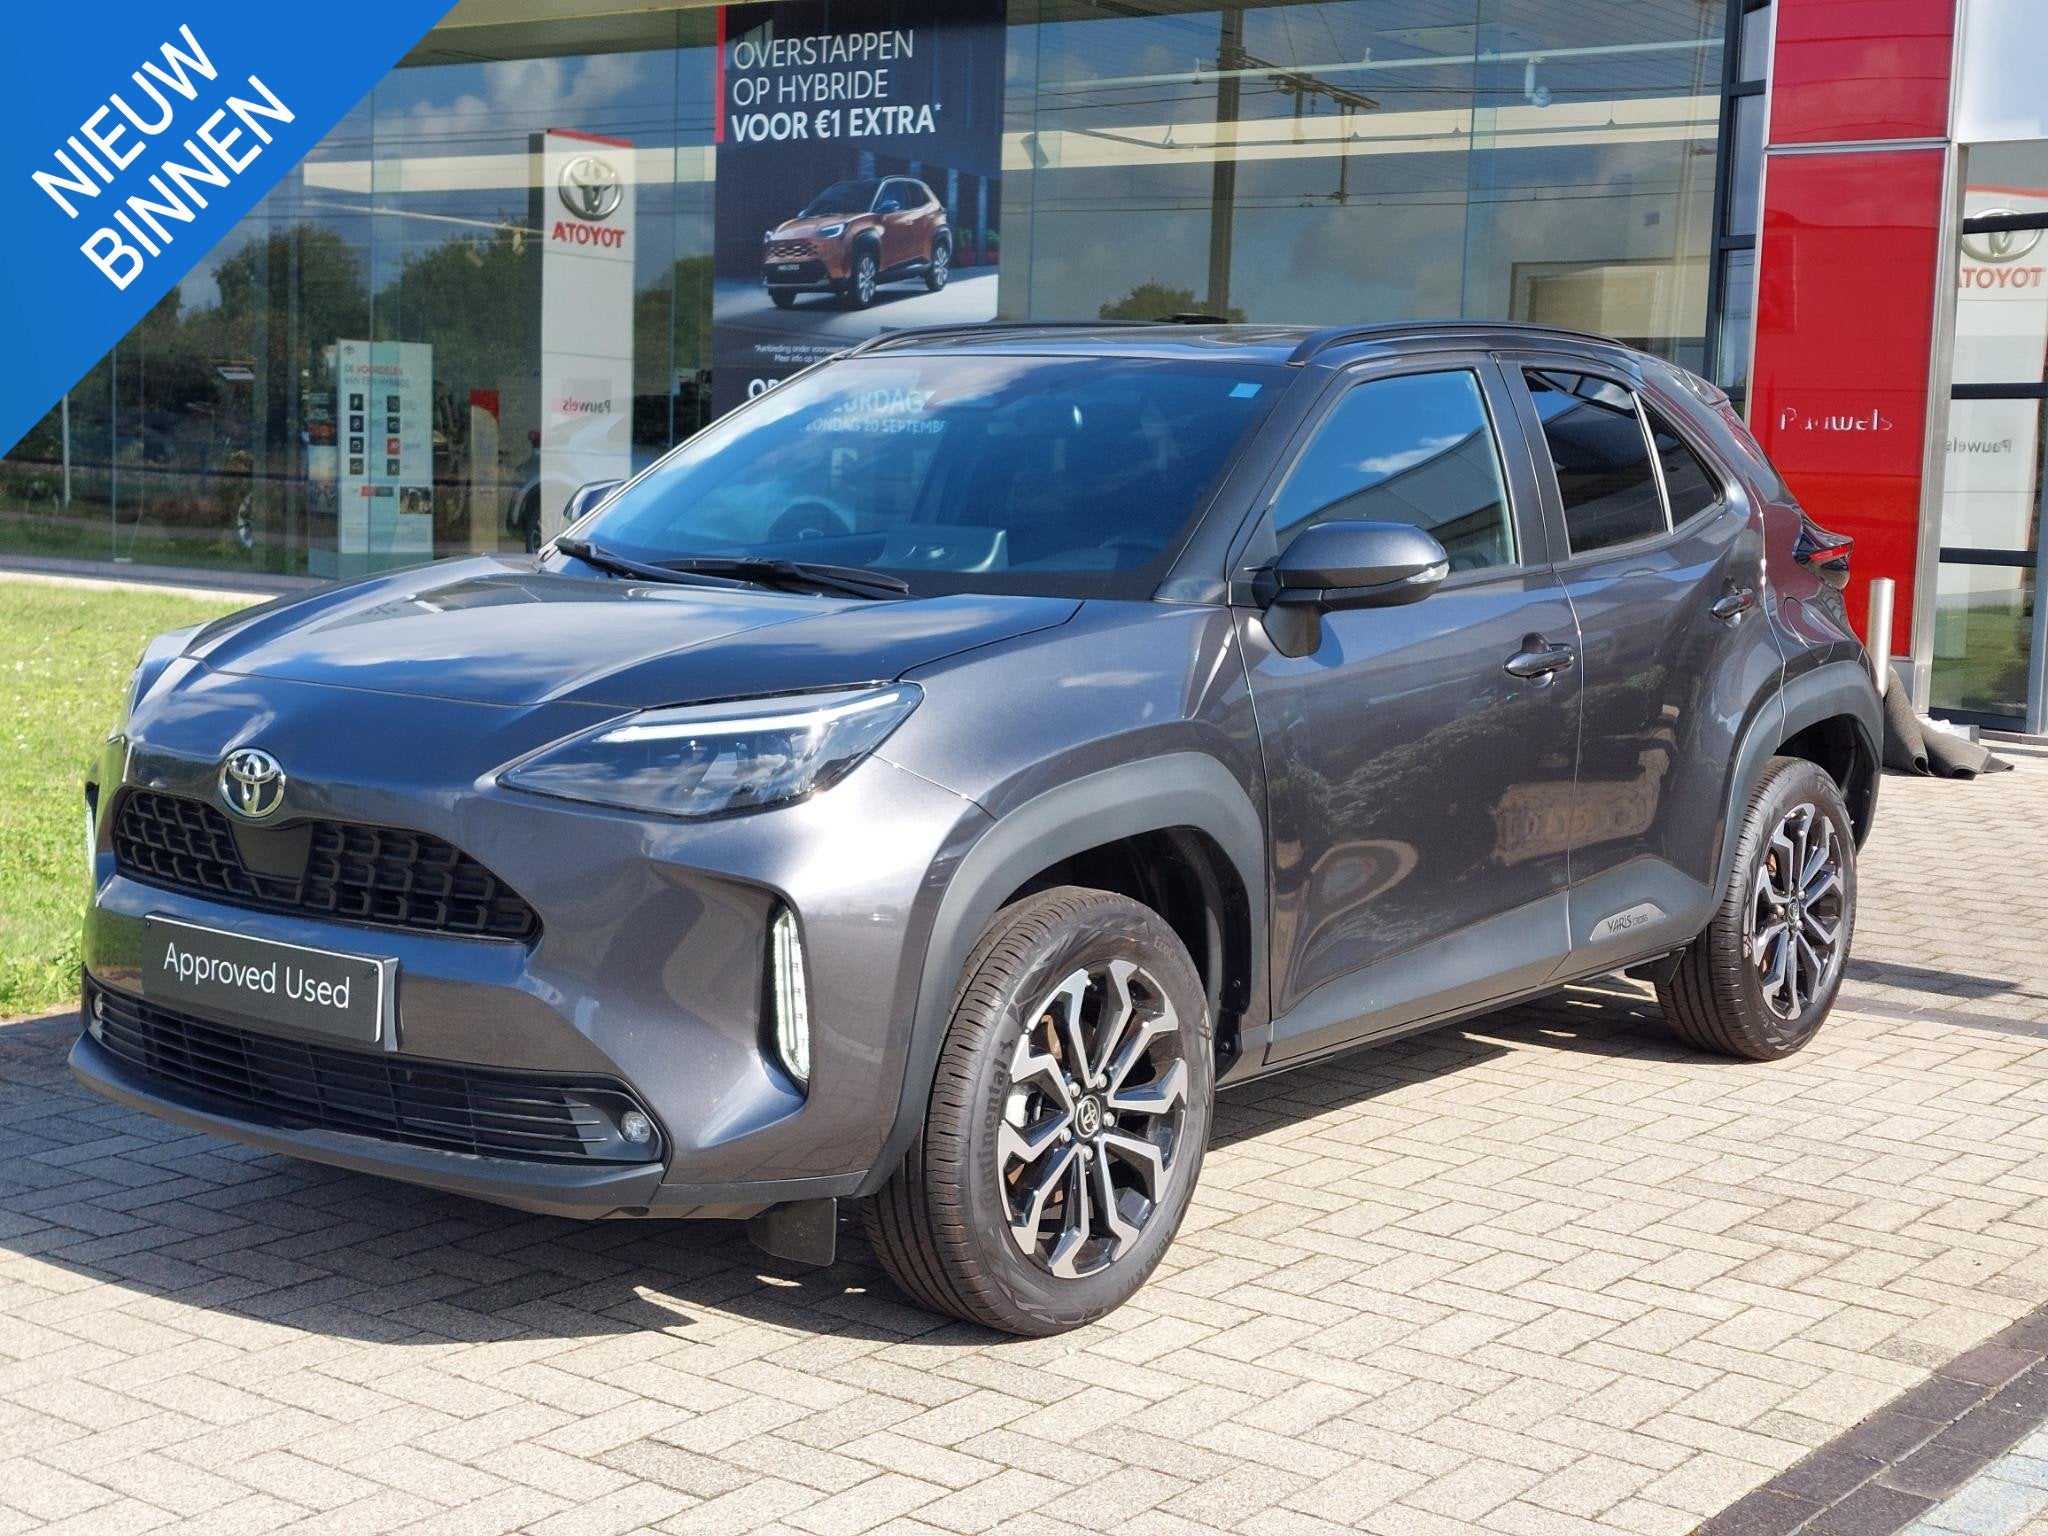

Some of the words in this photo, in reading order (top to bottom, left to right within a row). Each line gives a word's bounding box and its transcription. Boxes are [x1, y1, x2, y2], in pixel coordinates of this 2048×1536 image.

[734, 29, 914, 69] OVERSTAPPEN
[733, 77, 770, 106] OP
[778, 69, 888, 103] HYBRIDE
[731, 111, 808, 142] VOOR
[815, 109, 840, 138] €1
[163, 941, 276, 994] Approved
[285, 966, 350, 1009] Used
